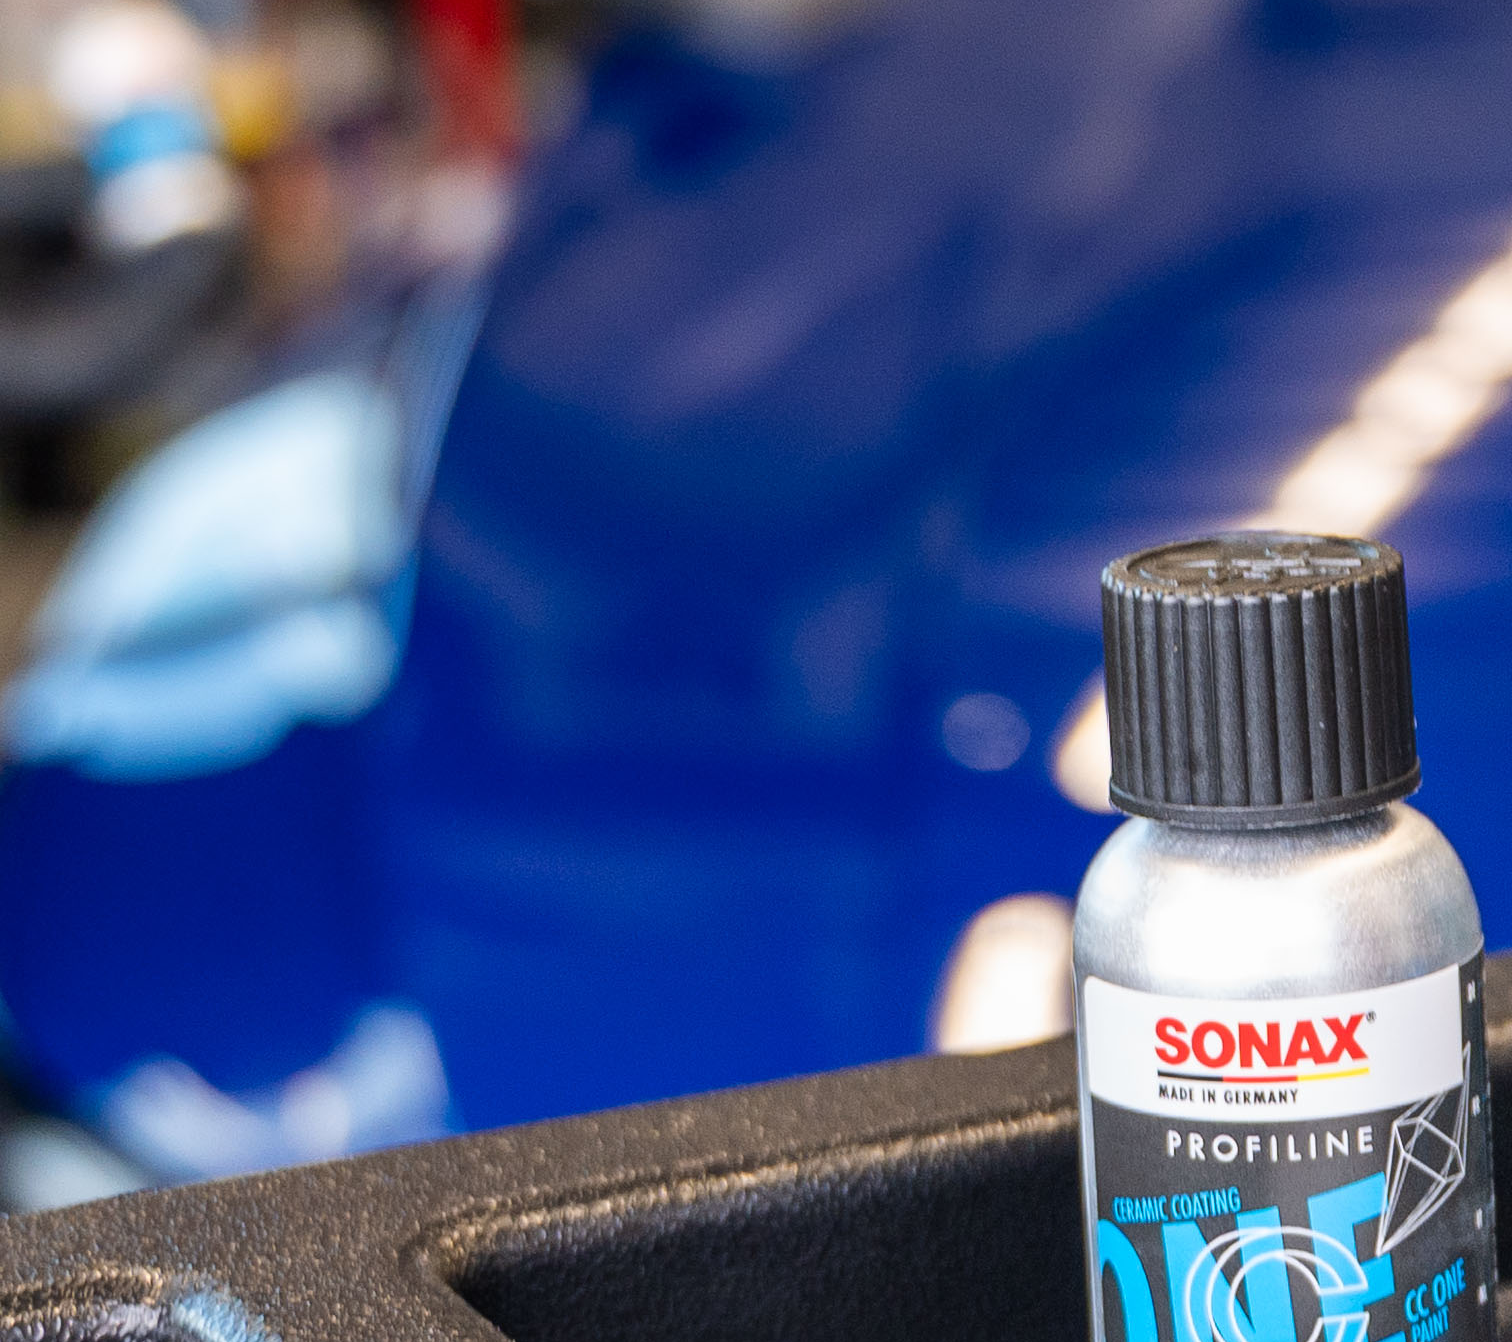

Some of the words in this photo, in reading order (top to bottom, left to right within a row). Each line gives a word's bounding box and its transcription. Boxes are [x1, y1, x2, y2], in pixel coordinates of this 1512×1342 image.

[1154, 1012, 1370, 1069] SONAX
[1158, 1083, 1195, 1102] MADE
[1201, 1088, 1217, 1103] IN
[1223, 1089, 1299, 1105] GERMANY
[1166, 1124, 1375, 1163] PROFILINE
[1112, 1195, 1169, 1224] CERAMIC
[1170, 1186, 1242, 1221] COATING
[1404, 1281, 1433, 1324] CC
[1433, 1258, 1468, 1310] ONE
